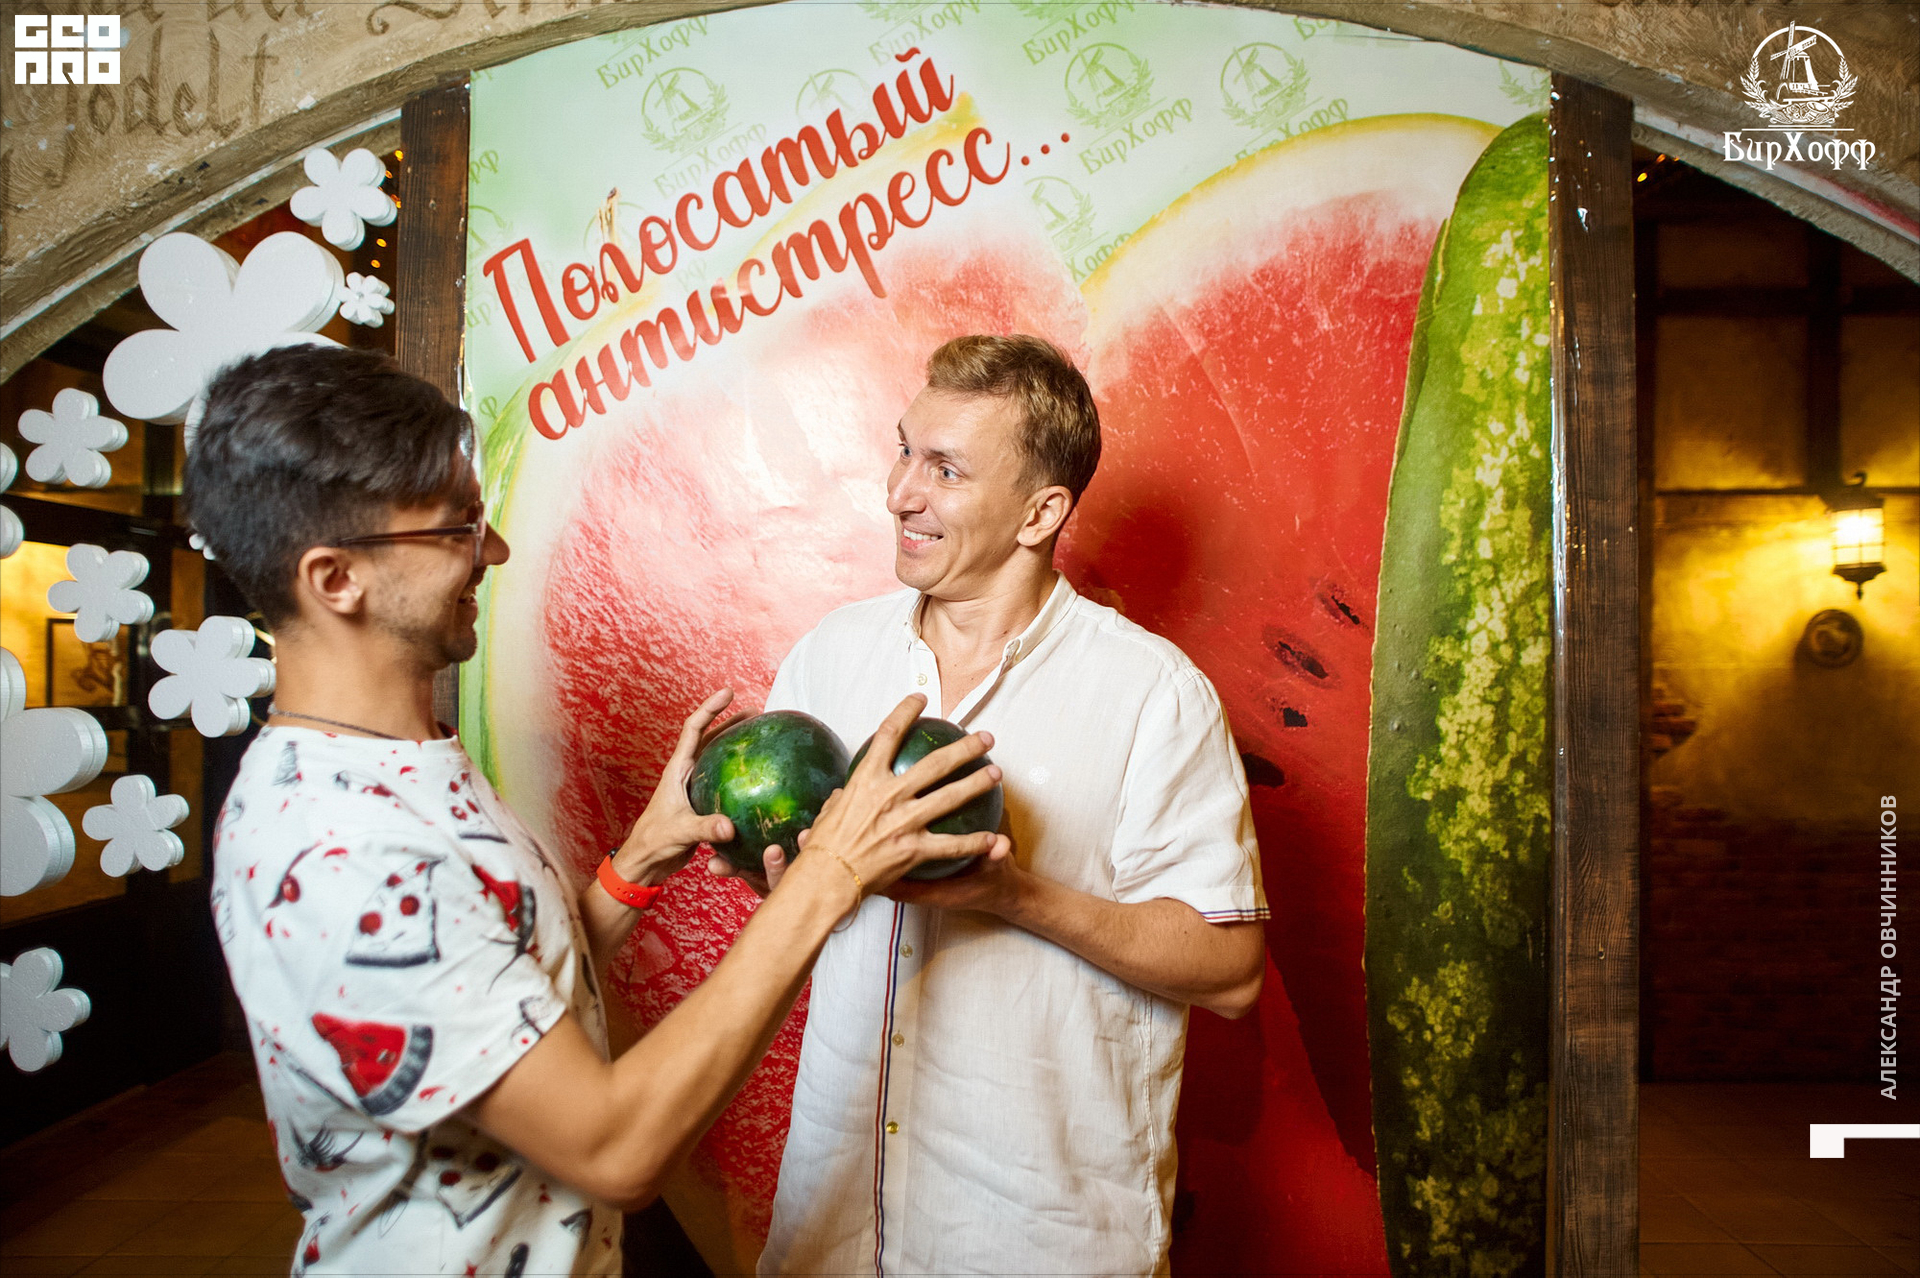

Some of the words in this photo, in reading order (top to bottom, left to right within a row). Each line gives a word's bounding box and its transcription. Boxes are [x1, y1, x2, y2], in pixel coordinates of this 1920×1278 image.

[595, 16, 709, 90] БирХофф
[1079, 98, 1193, 174] БирХофф
[483, 46, 955, 363] Полосатый
